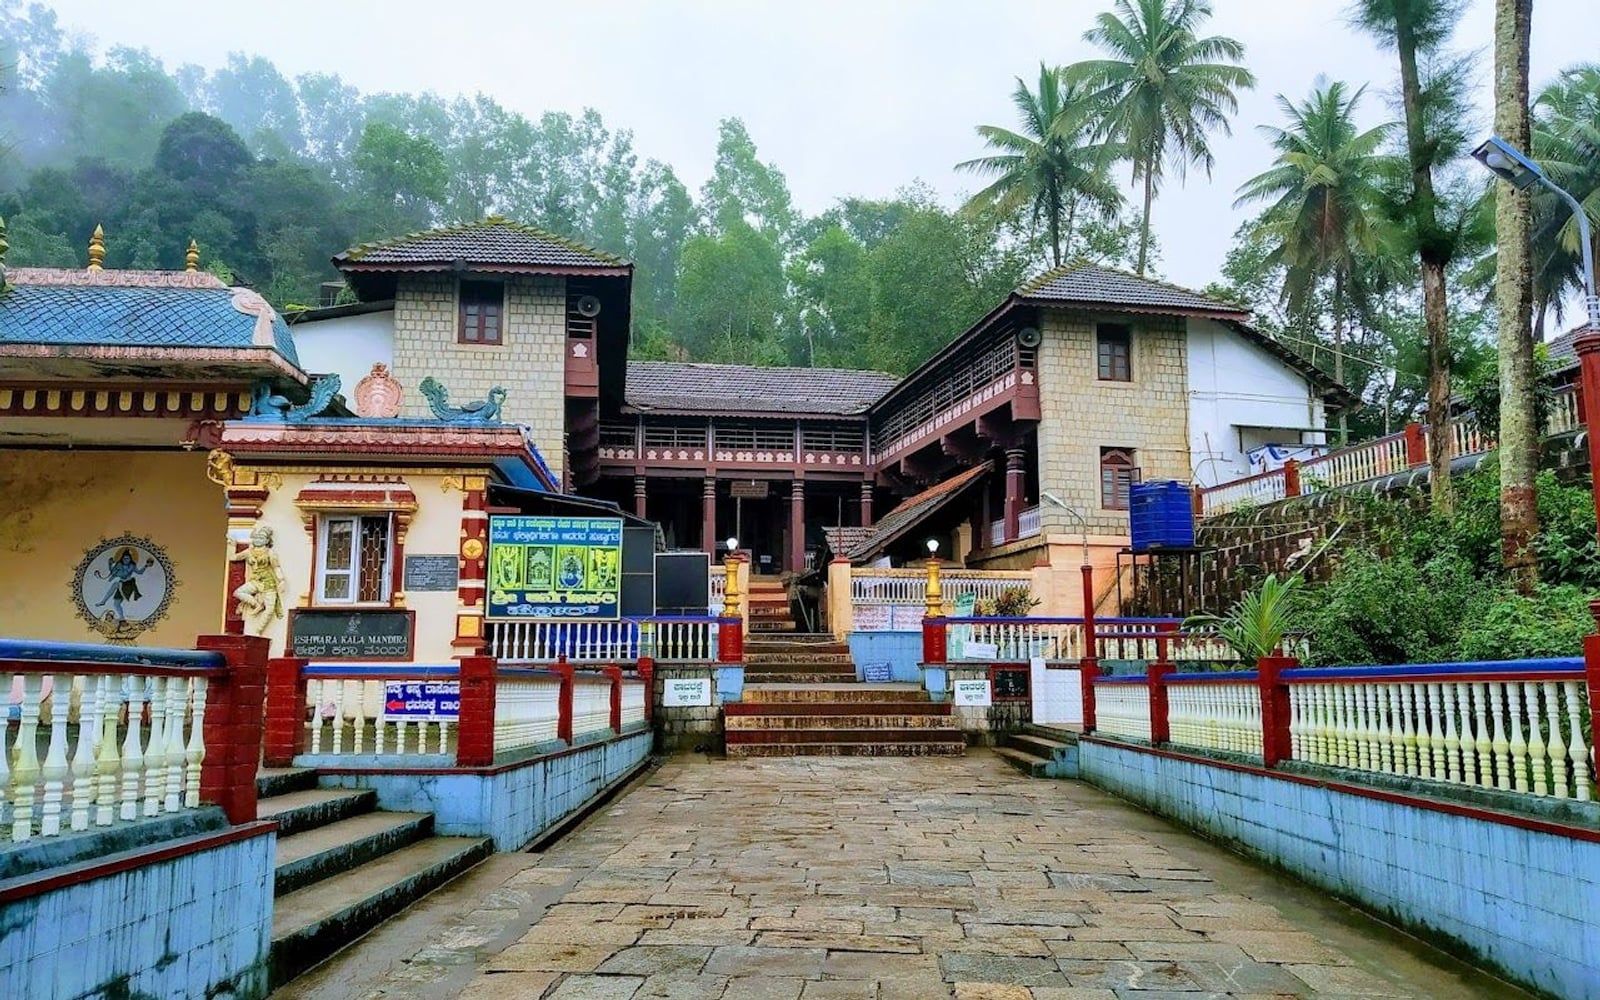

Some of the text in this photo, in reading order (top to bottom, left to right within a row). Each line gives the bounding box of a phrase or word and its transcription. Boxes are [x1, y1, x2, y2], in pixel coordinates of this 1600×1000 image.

[294, 634, 407, 645] ESHWARA KALA MANDIRA
